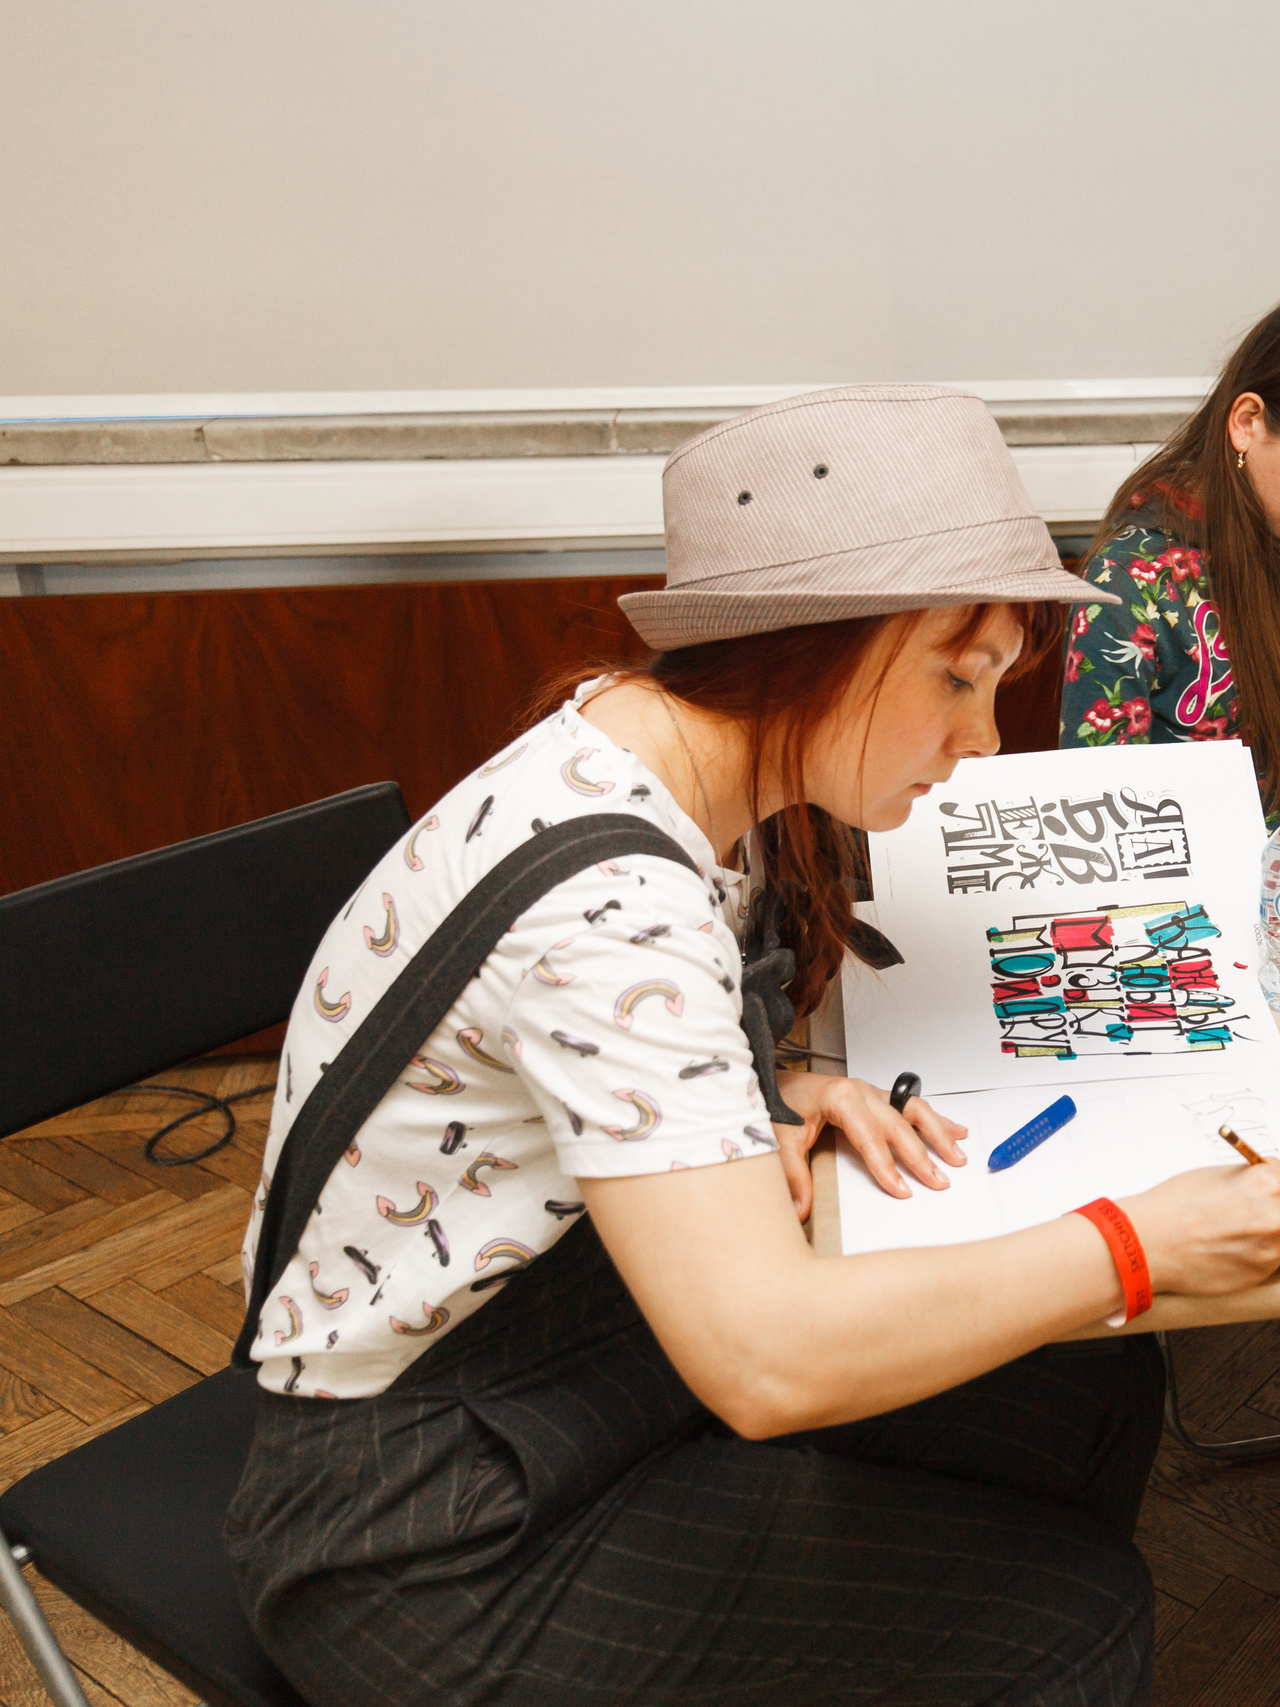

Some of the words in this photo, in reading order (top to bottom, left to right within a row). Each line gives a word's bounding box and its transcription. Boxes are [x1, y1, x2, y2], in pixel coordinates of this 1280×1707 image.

[986, 923, 1062, 1001] МОЙ
[1050, 915, 1132, 1042] МУЗЫКУ
[1098, 1204, 1141, 1274] SKETCHFEST
